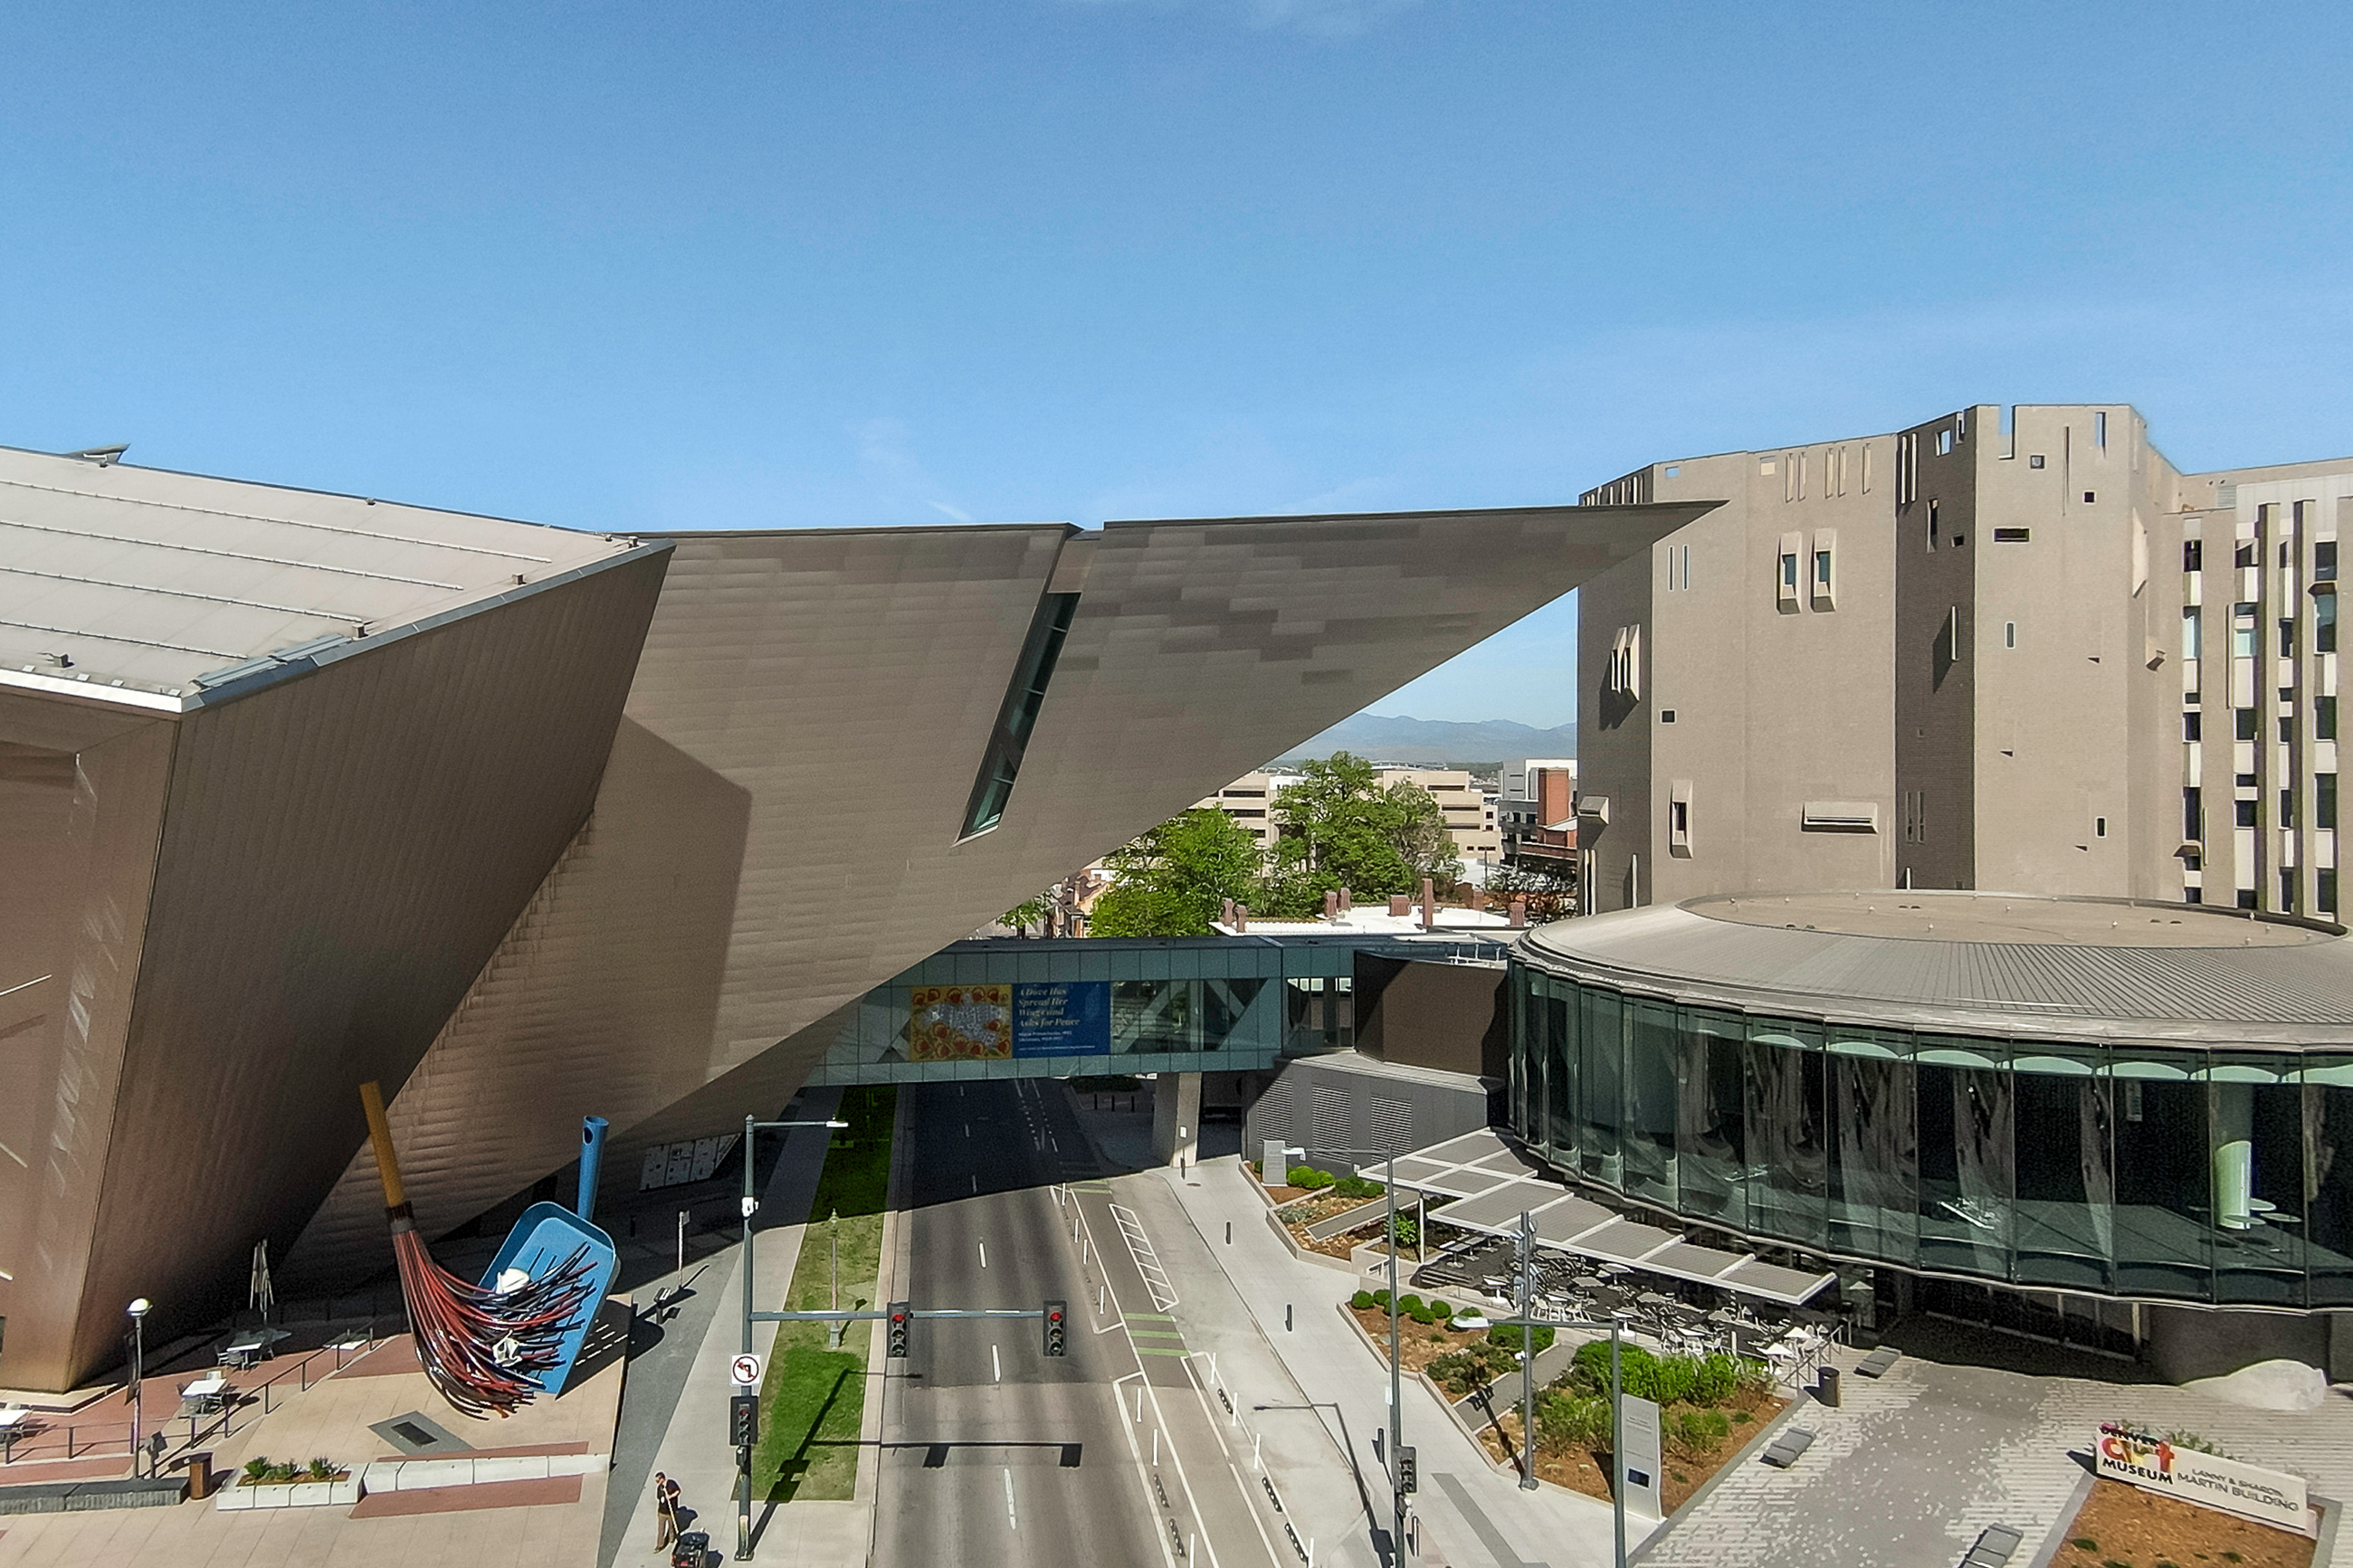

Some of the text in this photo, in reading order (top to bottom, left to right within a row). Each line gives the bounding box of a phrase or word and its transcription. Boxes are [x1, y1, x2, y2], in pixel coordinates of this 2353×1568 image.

[1025, 988, 1047, 996] Dove
[1050, 987, 1067, 995] Has
[1018, 997, 1069, 1008] Spread Her
[1019, 1007, 1064, 1018] Wings and
[1040, 1019, 1054, 1028] for
[1054, 1018, 1081, 1026] Peace
[2102, 1458, 2174, 1485] MUSEUM
[2177, 1473, 2299, 1512] MARTIN BUILDING
